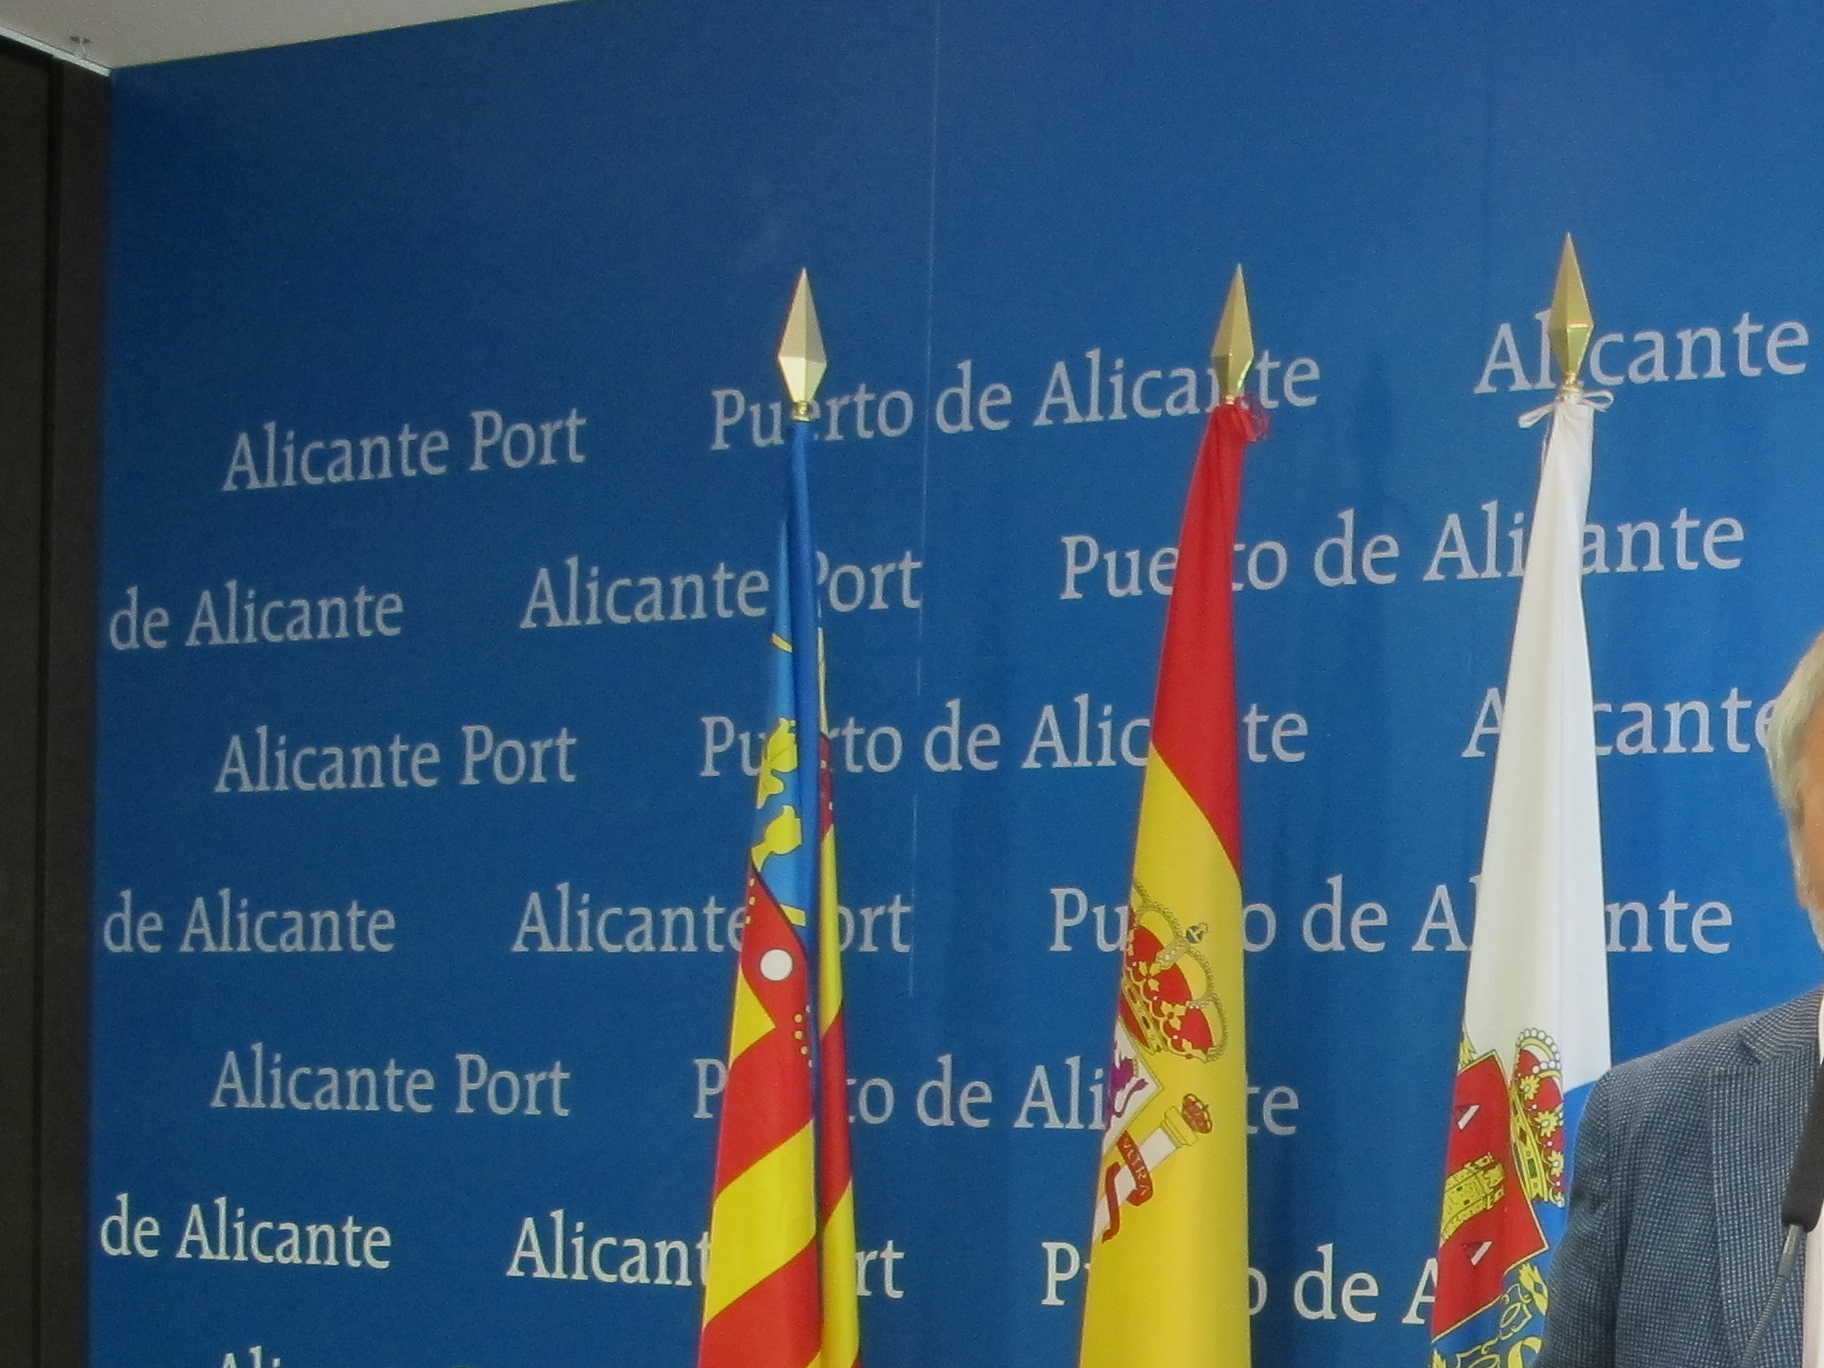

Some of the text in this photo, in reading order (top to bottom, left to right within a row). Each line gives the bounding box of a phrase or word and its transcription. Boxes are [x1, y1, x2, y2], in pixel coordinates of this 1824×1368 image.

[1474, 309, 1809, 394] Alcante
[936, 360, 1012, 433] de
[1033, 348, 1320, 426] Alicate
[224, 411, 586, 490] Alicante Port
[1060, 500, 1745, 600] Pueo de Aliante
[110, 581, 402, 649] de Alicante
[520, 557, 768, 628] Alicante
[216, 725, 576, 792] Alicante Port
[699, 693, 1308, 777] Puto de Alicte
[1461, 687, 1777, 758] Acant
[104, 888, 395, 952] de Alicante
[1303, 875, 1387, 952] de
[211, 1043, 570, 1116] Alicante Port
[917, 1054, 992, 1128] de
[100, 1193, 391, 1269] de Alicante
[508, 1208, 710, 1287] Alicant
[1292, 1243, 1380, 1323] de
